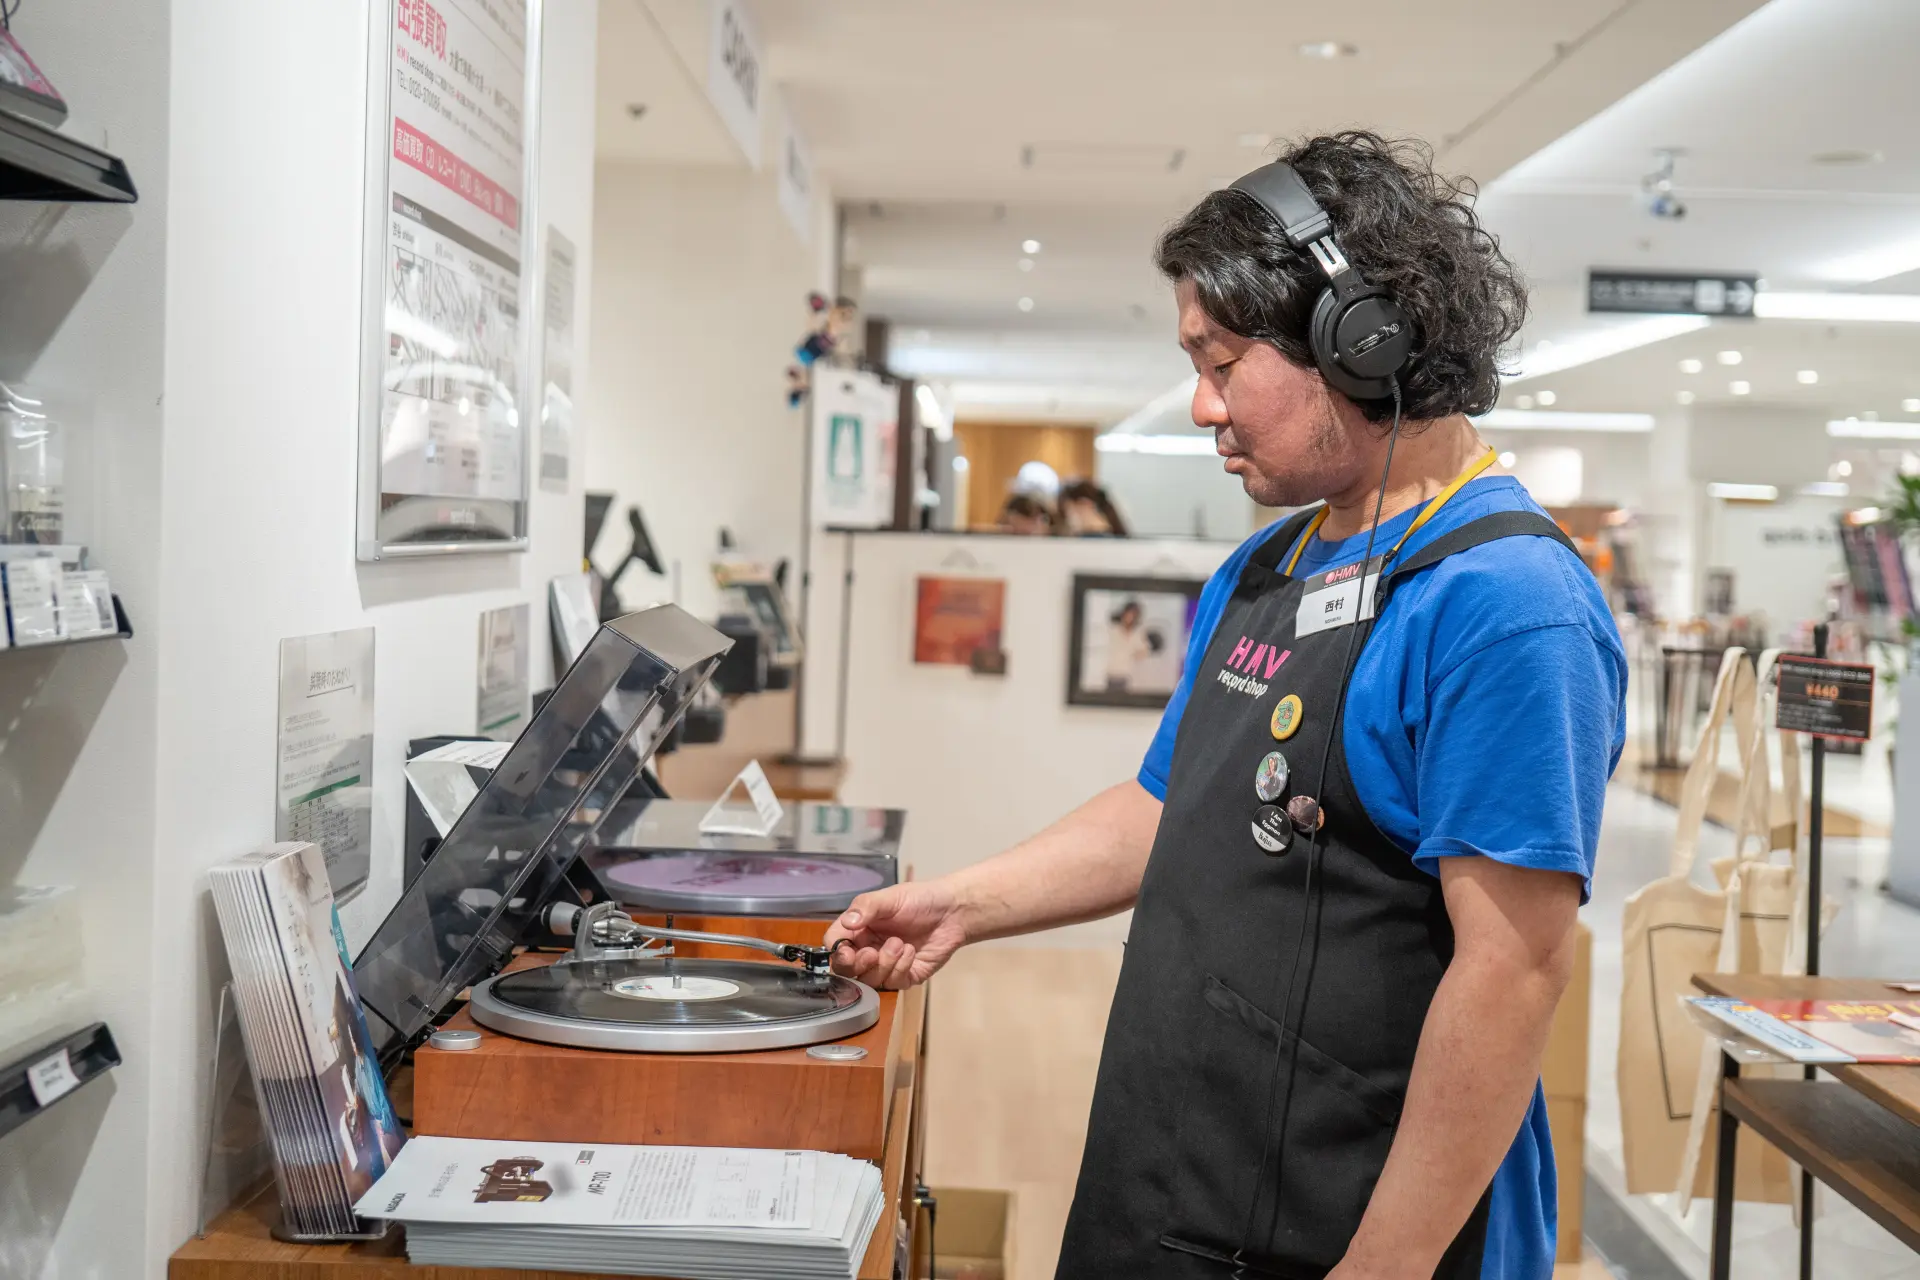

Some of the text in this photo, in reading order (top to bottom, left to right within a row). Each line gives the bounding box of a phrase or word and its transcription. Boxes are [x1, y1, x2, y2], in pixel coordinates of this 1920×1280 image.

[1333, 563, 1361, 582] HMV
[1324, 597, 1345, 613] 西村
[1226, 635, 1292, 680] HMV
[1217, 669, 1268, 700] record shop
[1262, 819, 1281, 837] Eggman
[587, 1171, 612, 1196] MP-700
